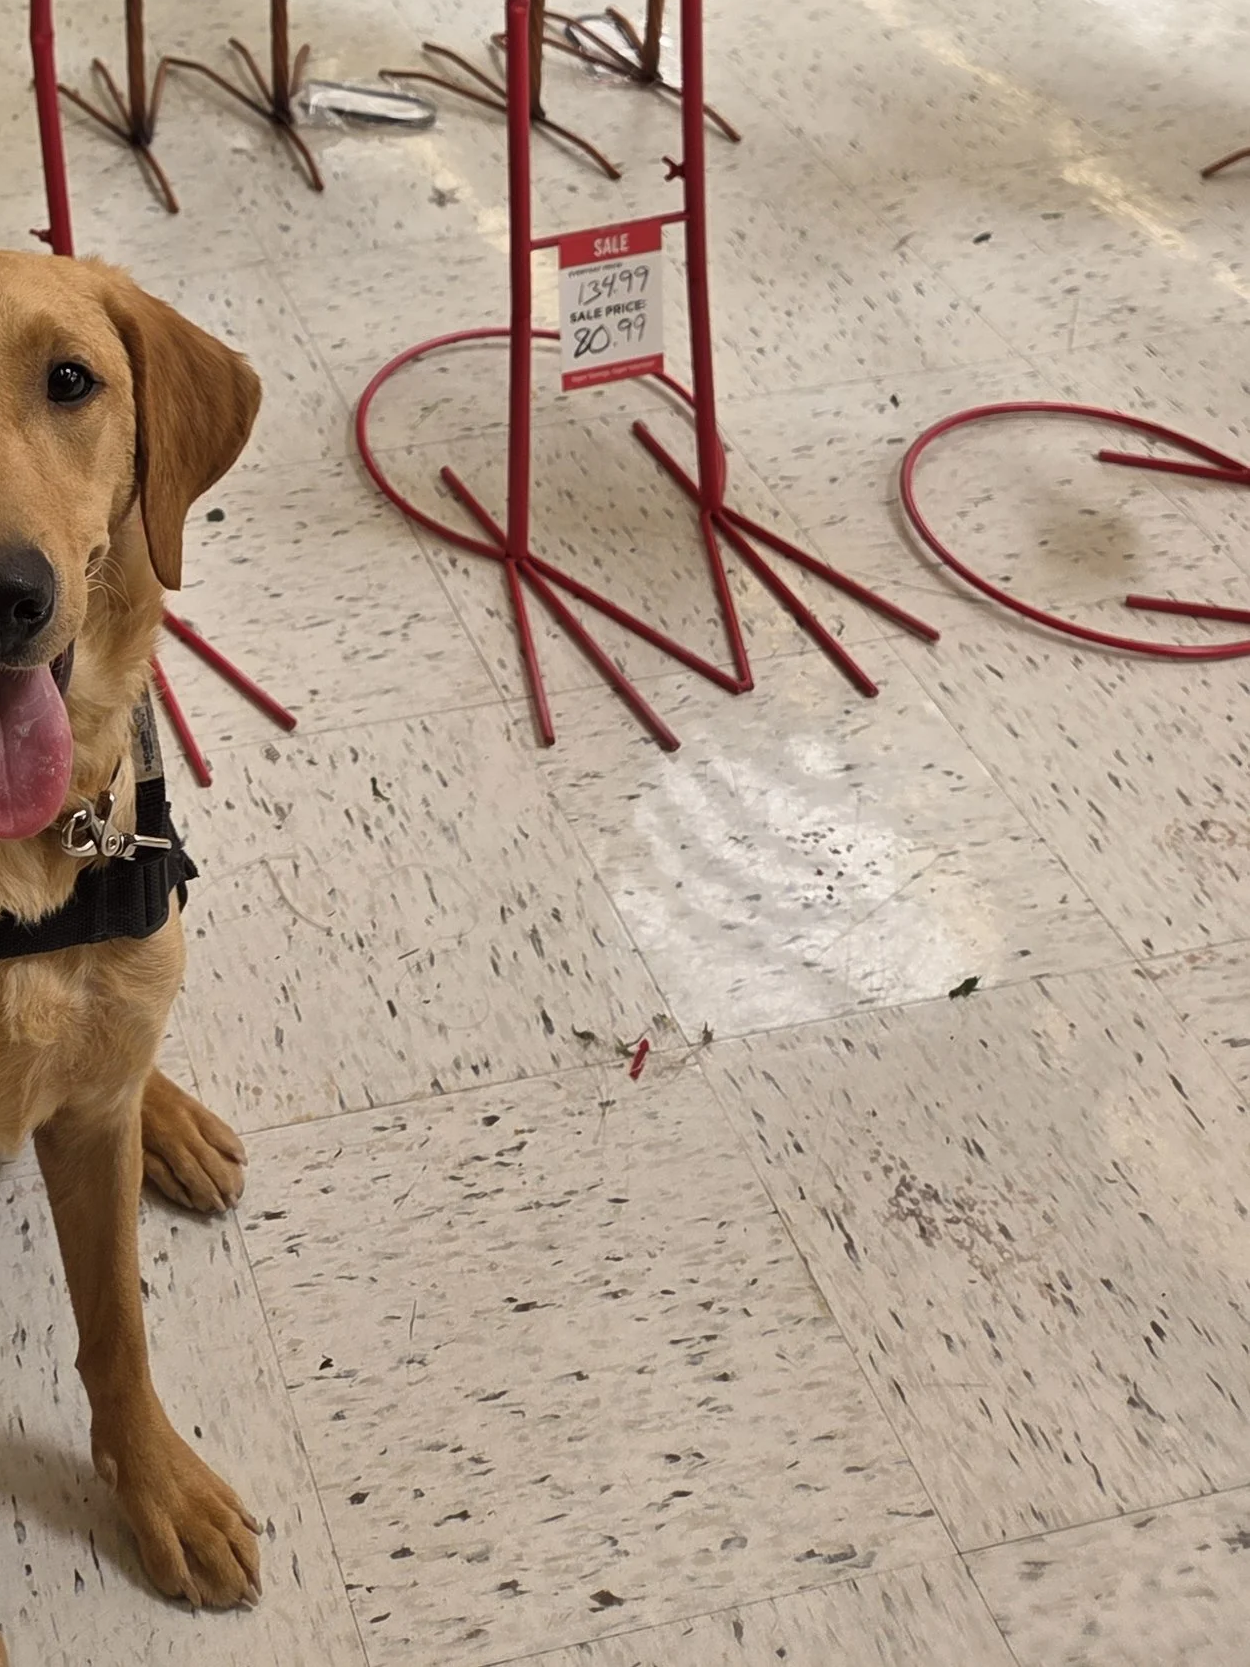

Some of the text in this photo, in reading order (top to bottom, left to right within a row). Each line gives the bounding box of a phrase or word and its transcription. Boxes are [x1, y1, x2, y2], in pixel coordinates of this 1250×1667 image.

[593, 233, 630, 257] SALE
[578, 265, 650, 305] 134.99
[569, 299, 646, 324] SALE PRICE:
[573, 314, 646, 358] 80.99
